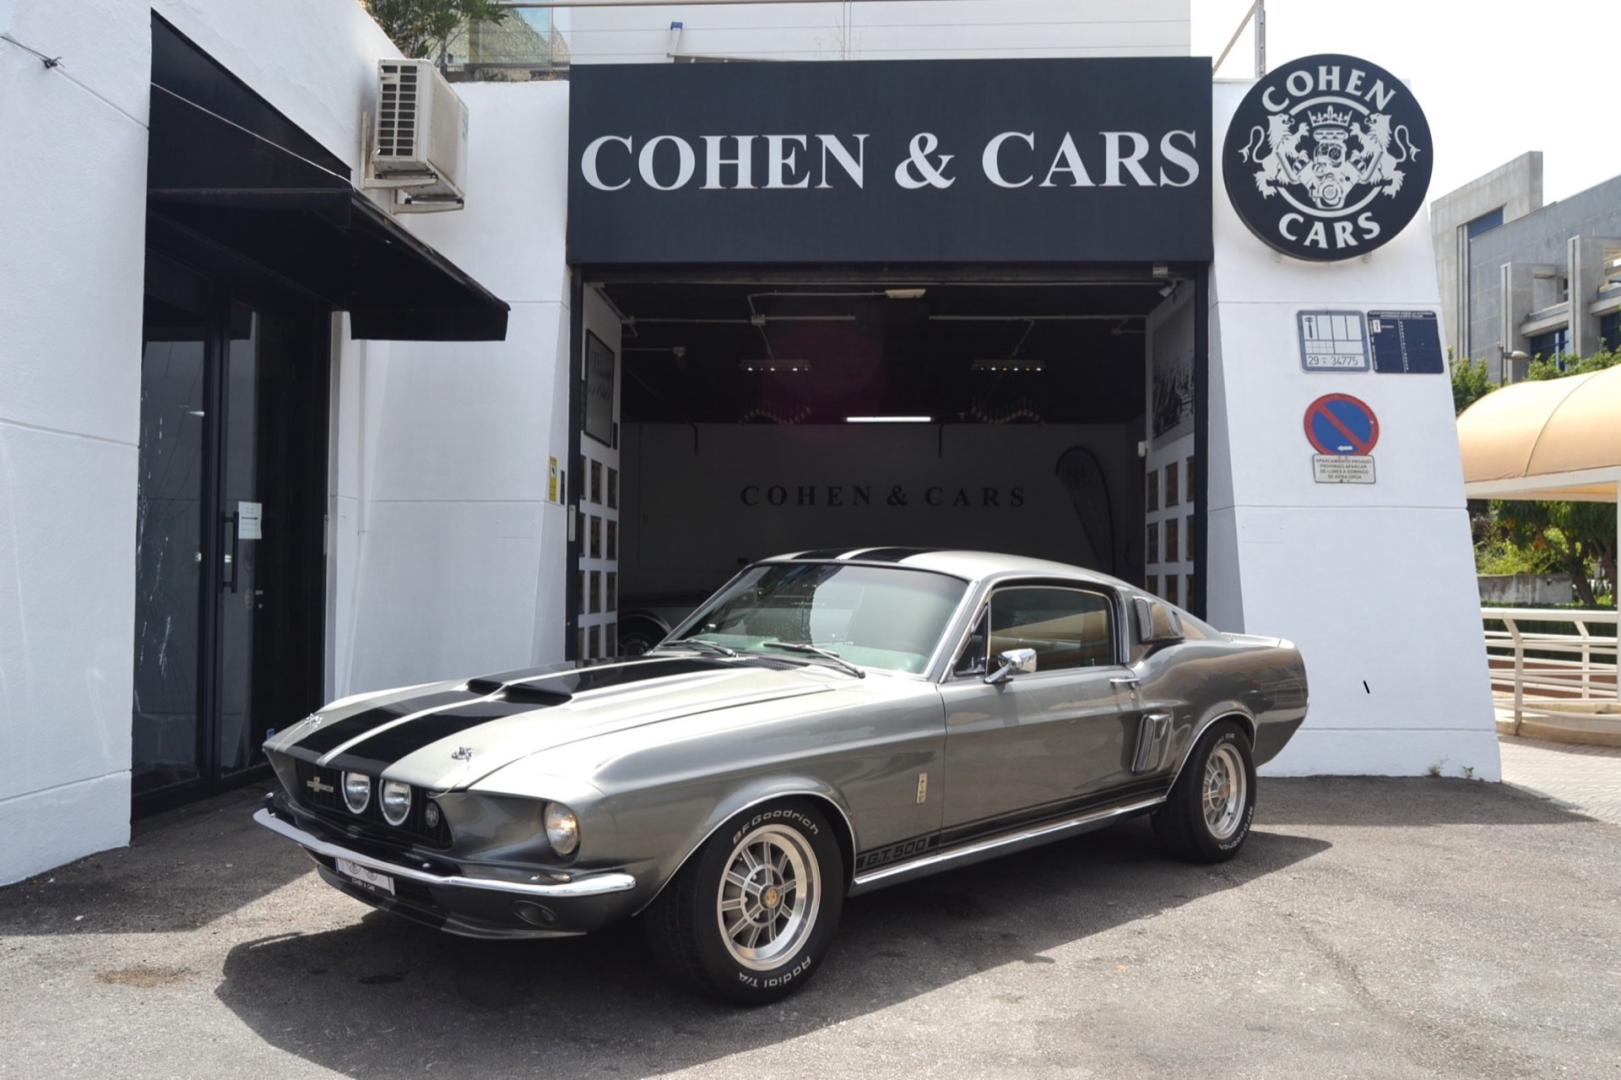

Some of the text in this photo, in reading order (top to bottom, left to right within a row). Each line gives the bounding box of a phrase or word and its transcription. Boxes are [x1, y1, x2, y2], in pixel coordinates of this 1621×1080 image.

[1262, 65, 1396, 112] COHEN
[580, 129, 1201, 191] COHEN & CARS
[1278, 211, 1381, 249] CARS
[740, 484, 1025, 508] COHEN & CARS
[733, 809, 819, 845] BFGoodrich
[764, 955, 812, 988] Radial
